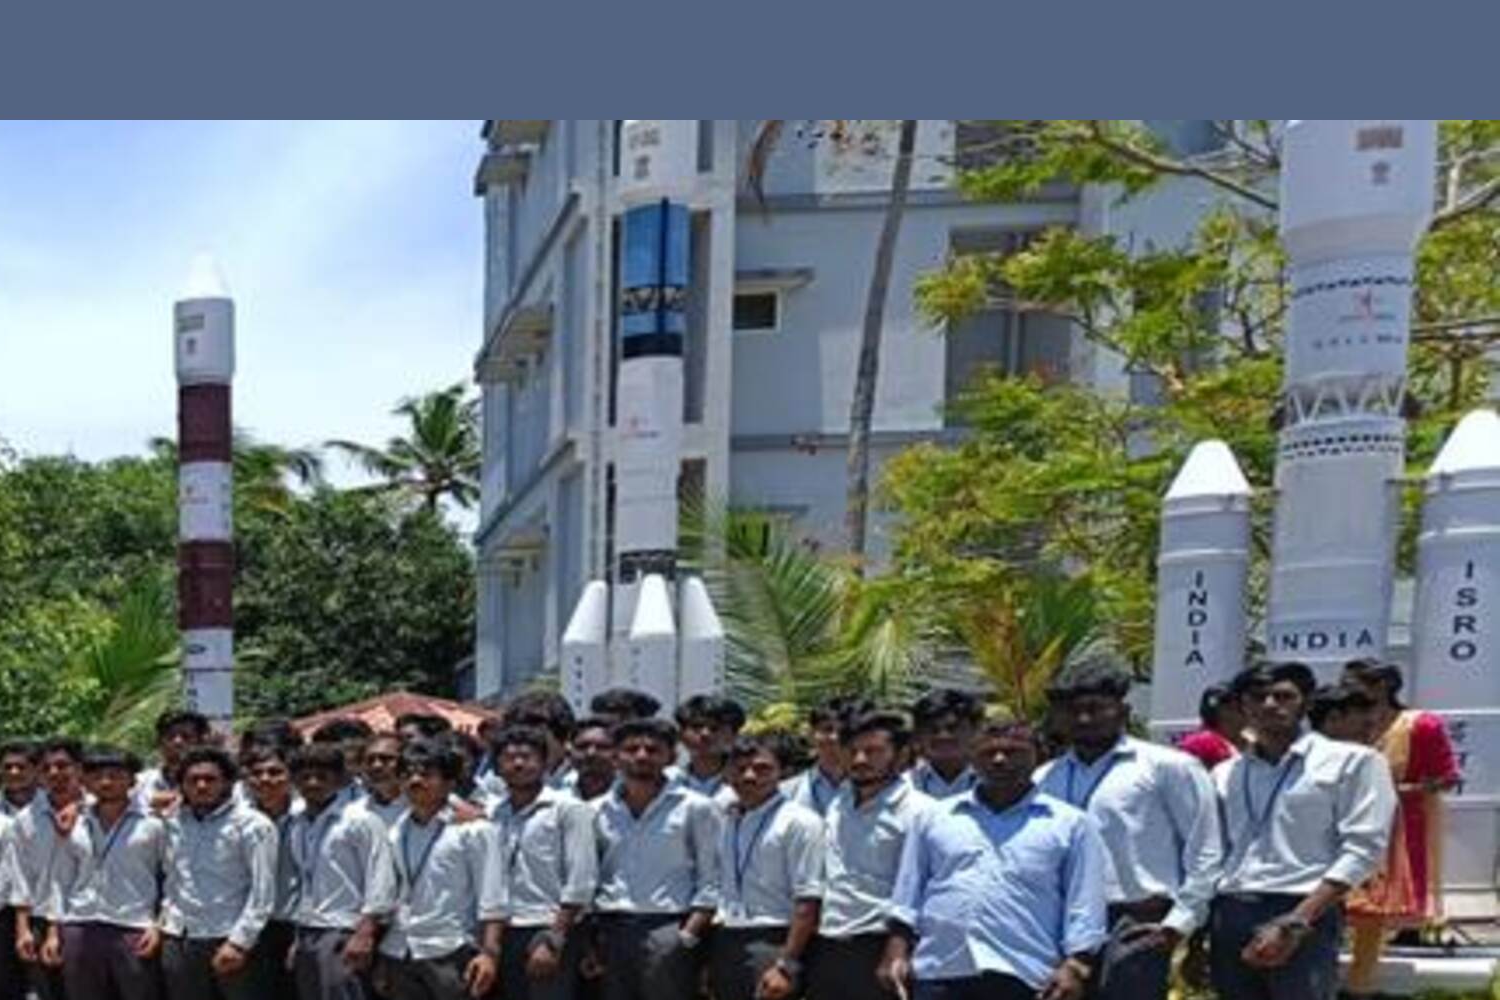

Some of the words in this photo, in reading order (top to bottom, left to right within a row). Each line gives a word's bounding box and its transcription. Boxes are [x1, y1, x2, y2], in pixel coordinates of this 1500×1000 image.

[1184, 569, 1208, 667] INDIA
[1271, 626, 1374, 652] INDIA
[1450, 559, 1478, 662] ISRO
